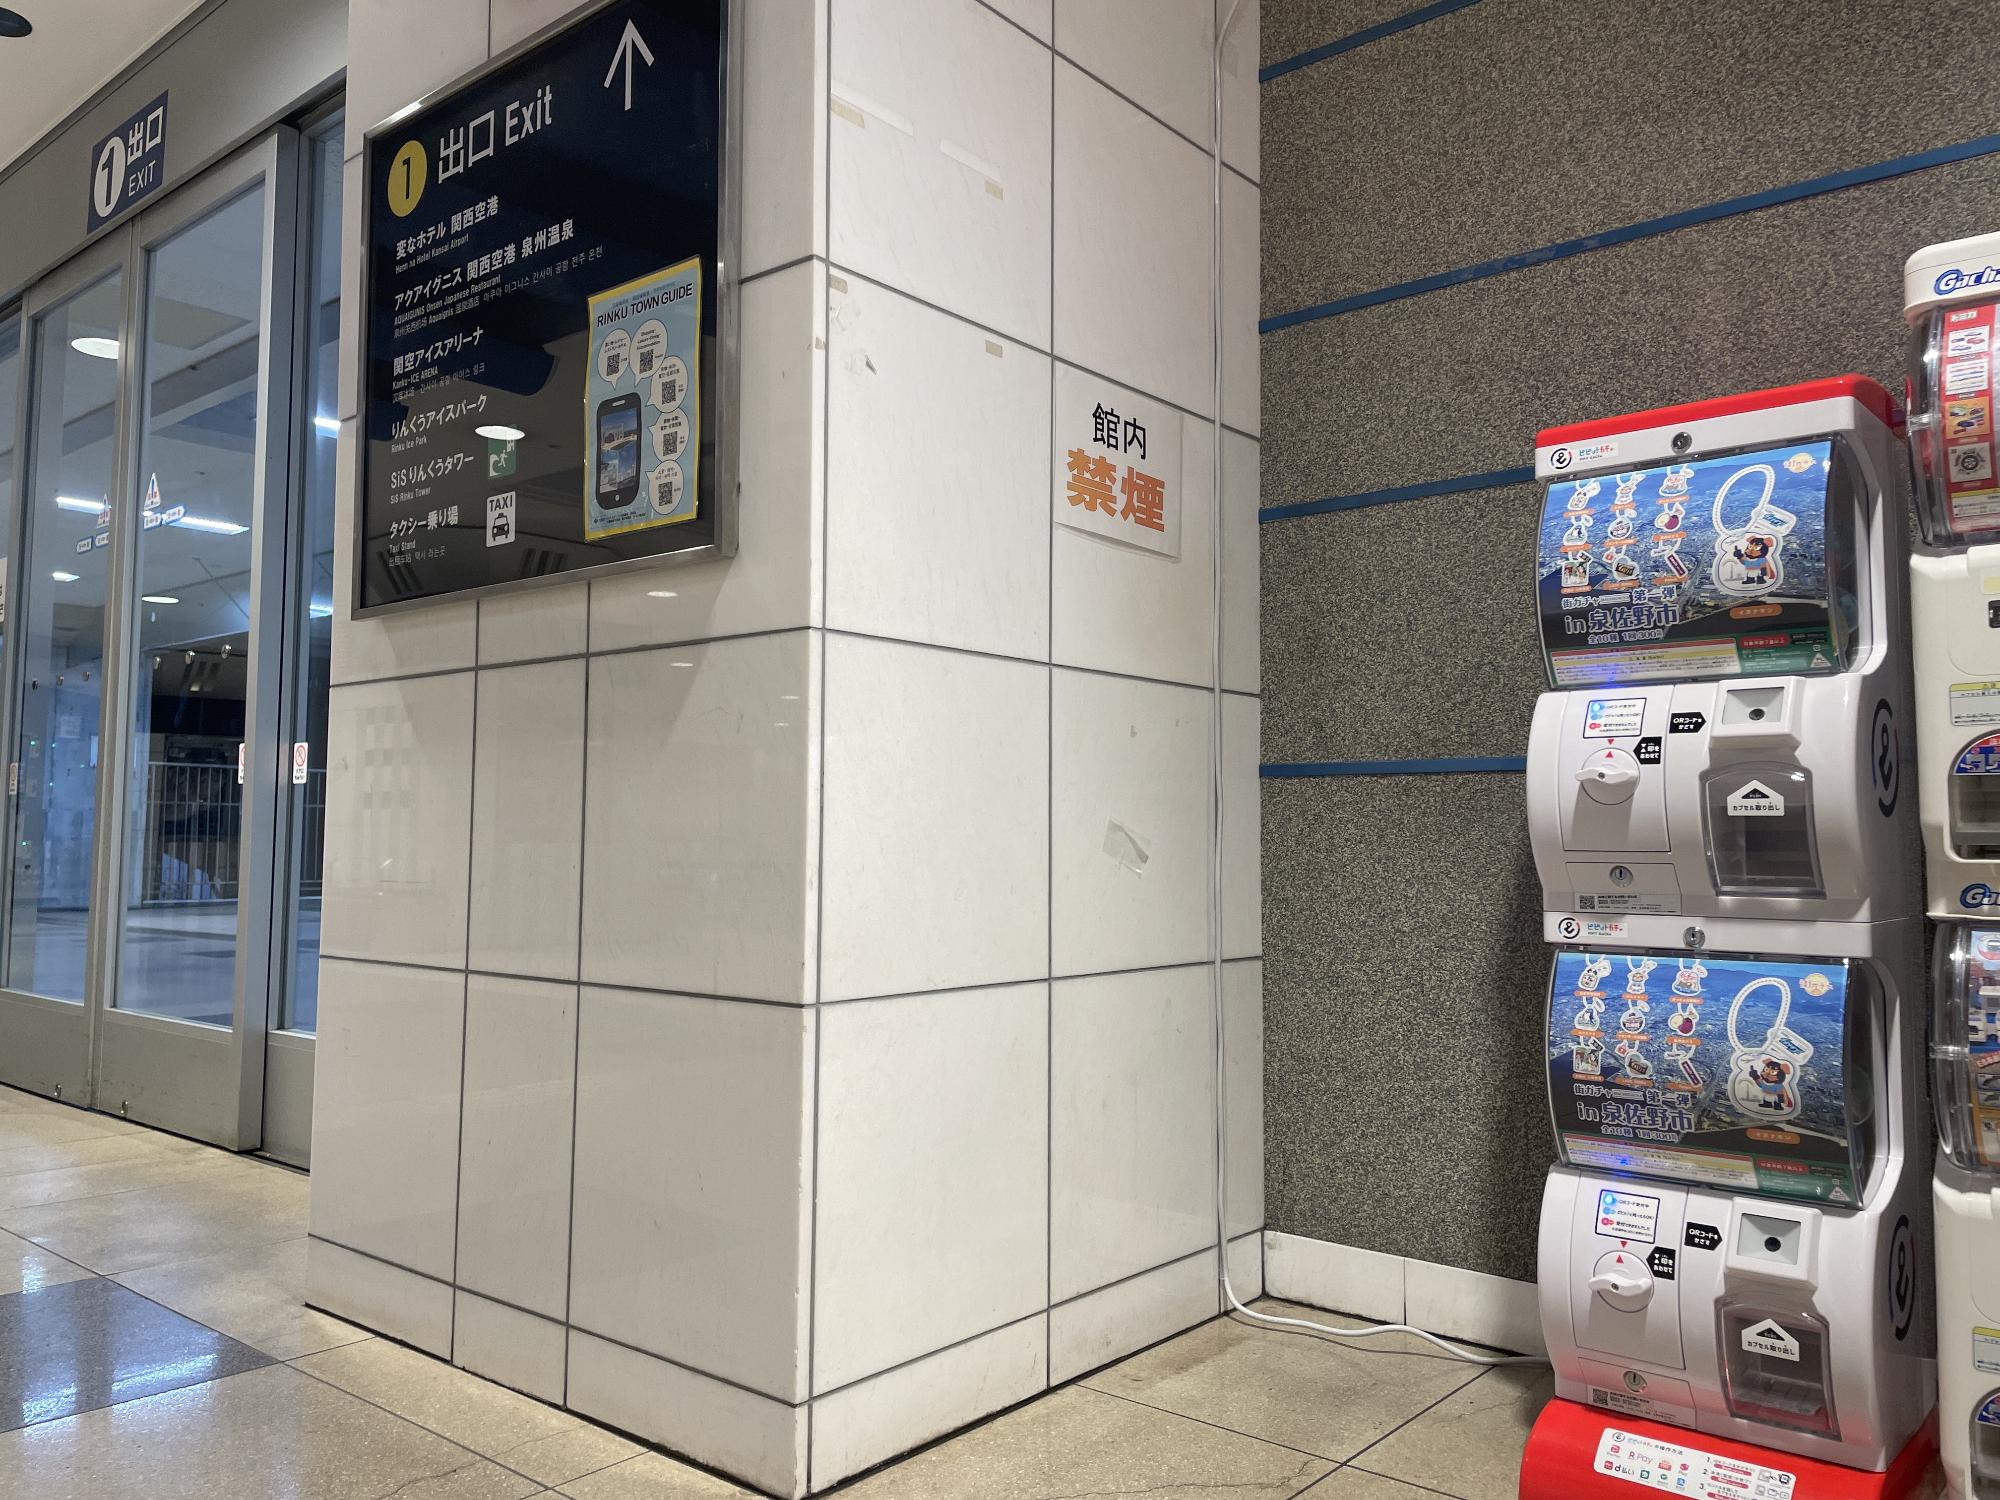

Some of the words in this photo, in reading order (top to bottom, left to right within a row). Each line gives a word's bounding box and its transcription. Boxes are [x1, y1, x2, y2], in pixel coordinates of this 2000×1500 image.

[102, 146, 115, 208] 1
[127, 105, 164, 166] 出口
[402, 156, 411, 201] 1
[438, 109, 495, 185] 出口
[505, 84, 552, 147] Exit
[128, 160, 156, 197] EXIT
[396, 221, 447, 261] 変なホテル
[450, 195, 499, 235] 関西空港
[395, 267, 462, 312] アクアイグニス
[466, 242, 516, 282] 関西空港
[521, 218, 574, 258] 泉州温泉
[416, 251, 431, 265] Hotel
[431, 242, 450, 259] Kansai
[450, 232, 470, 250] Airport
[426, 299, 443, 312] Onsen
[443, 287, 470, 306] Japanese
[470, 273, 501, 298] Restaurant
[596, 306, 629, 328] RINKU
[631, 295, 660, 315] TOWN
[661, 282, 693, 305] GUIDE
[392, 326, 484, 378] 関空アイスアリーナ
[420, 365, 439, 380] ARENA
[391, 393, 488, 440] りんくうアイスパーク
[1092, 402, 1147, 460] 館内
[391, 442, 405, 453] Rinku
[406, 439, 414, 450] Ice
[415, 434, 428, 447] Park
[390, 469, 407, 489] SiS
[409, 452, 475, 484] りんくうタワー
[399, 489, 414, 502] Rinku
[415, 486, 432, 498] Tower
[489, 495, 513, 512] TAXI
[1066, 447, 1166, 533] 禁煙
[390, 505, 459, 540] タクシー乗り場
[389, 542, 401, 555] Taxi
[401, 538, 416, 551] Stand
[1564, 615, 1587, 635] in
[1588, 603, 1680, 632] 泉佐野市
[1576, 1101, 1600, 1122] in
[1601, 1100, 1695, 1133] 泉佐野市
[1636, 1453, 1653, 1465] Pay
